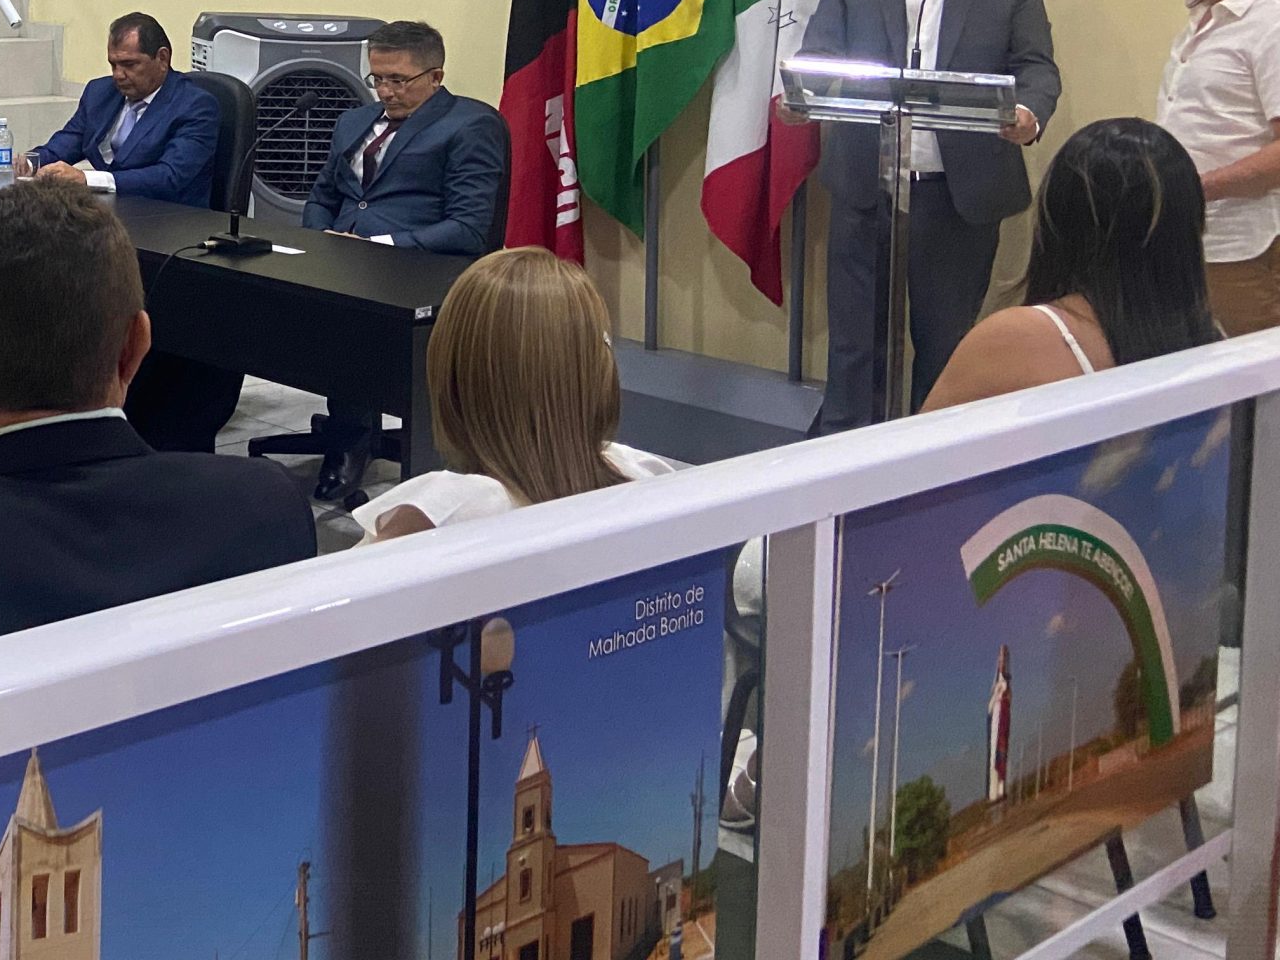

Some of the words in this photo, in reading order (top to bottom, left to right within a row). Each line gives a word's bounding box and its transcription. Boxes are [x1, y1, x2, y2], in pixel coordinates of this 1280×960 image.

[997, 534, 1037, 572] SANTA
[1038, 531, 1079, 553] HELENA
[1079, 540, 1095, 561] TE
[635, 591, 681, 620] Distrito
[685, 584, 705, 605] de
[588, 622, 656, 659] Malhada
[660, 608, 705, 636] Bonita
